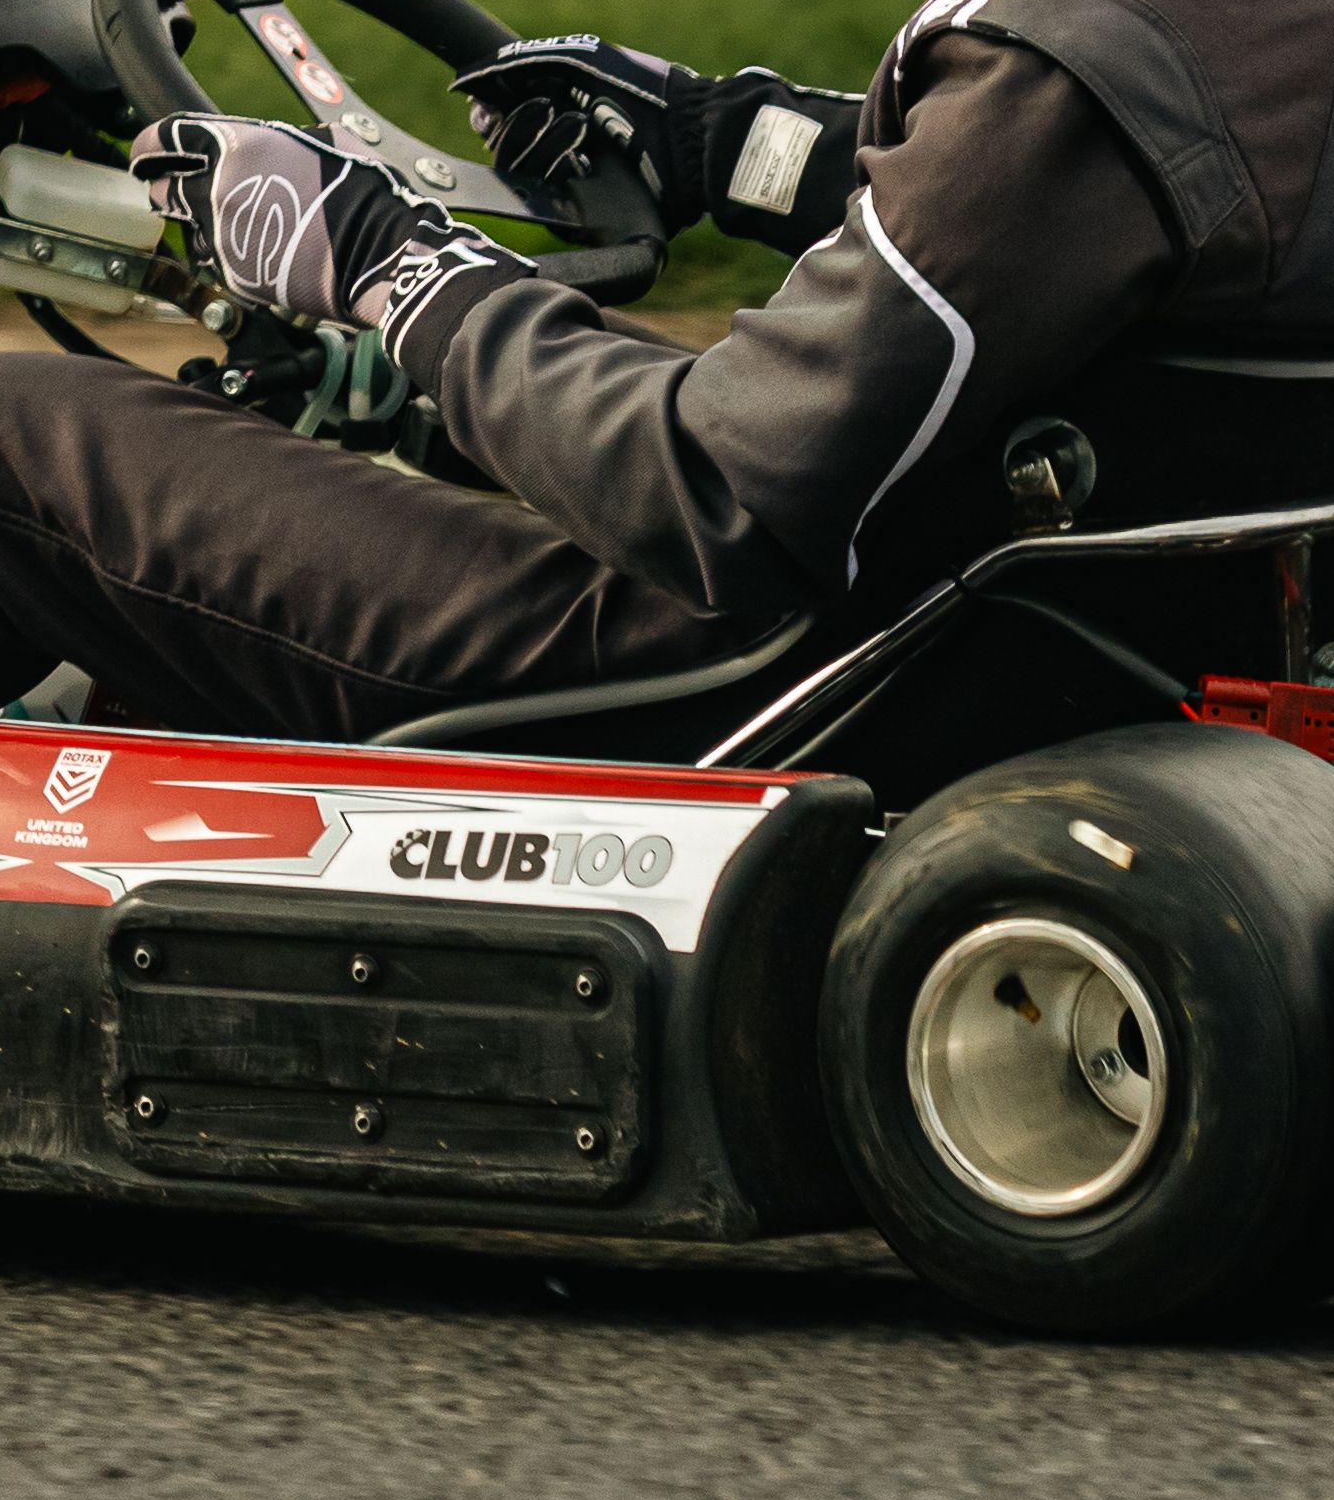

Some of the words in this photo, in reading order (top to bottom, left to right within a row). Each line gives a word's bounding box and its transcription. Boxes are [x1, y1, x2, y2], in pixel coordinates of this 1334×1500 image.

[62, 752, 105, 764] ROTAX
[27, 818, 85, 835] UNITED
[14, 830, 89, 849] KINGDOM
